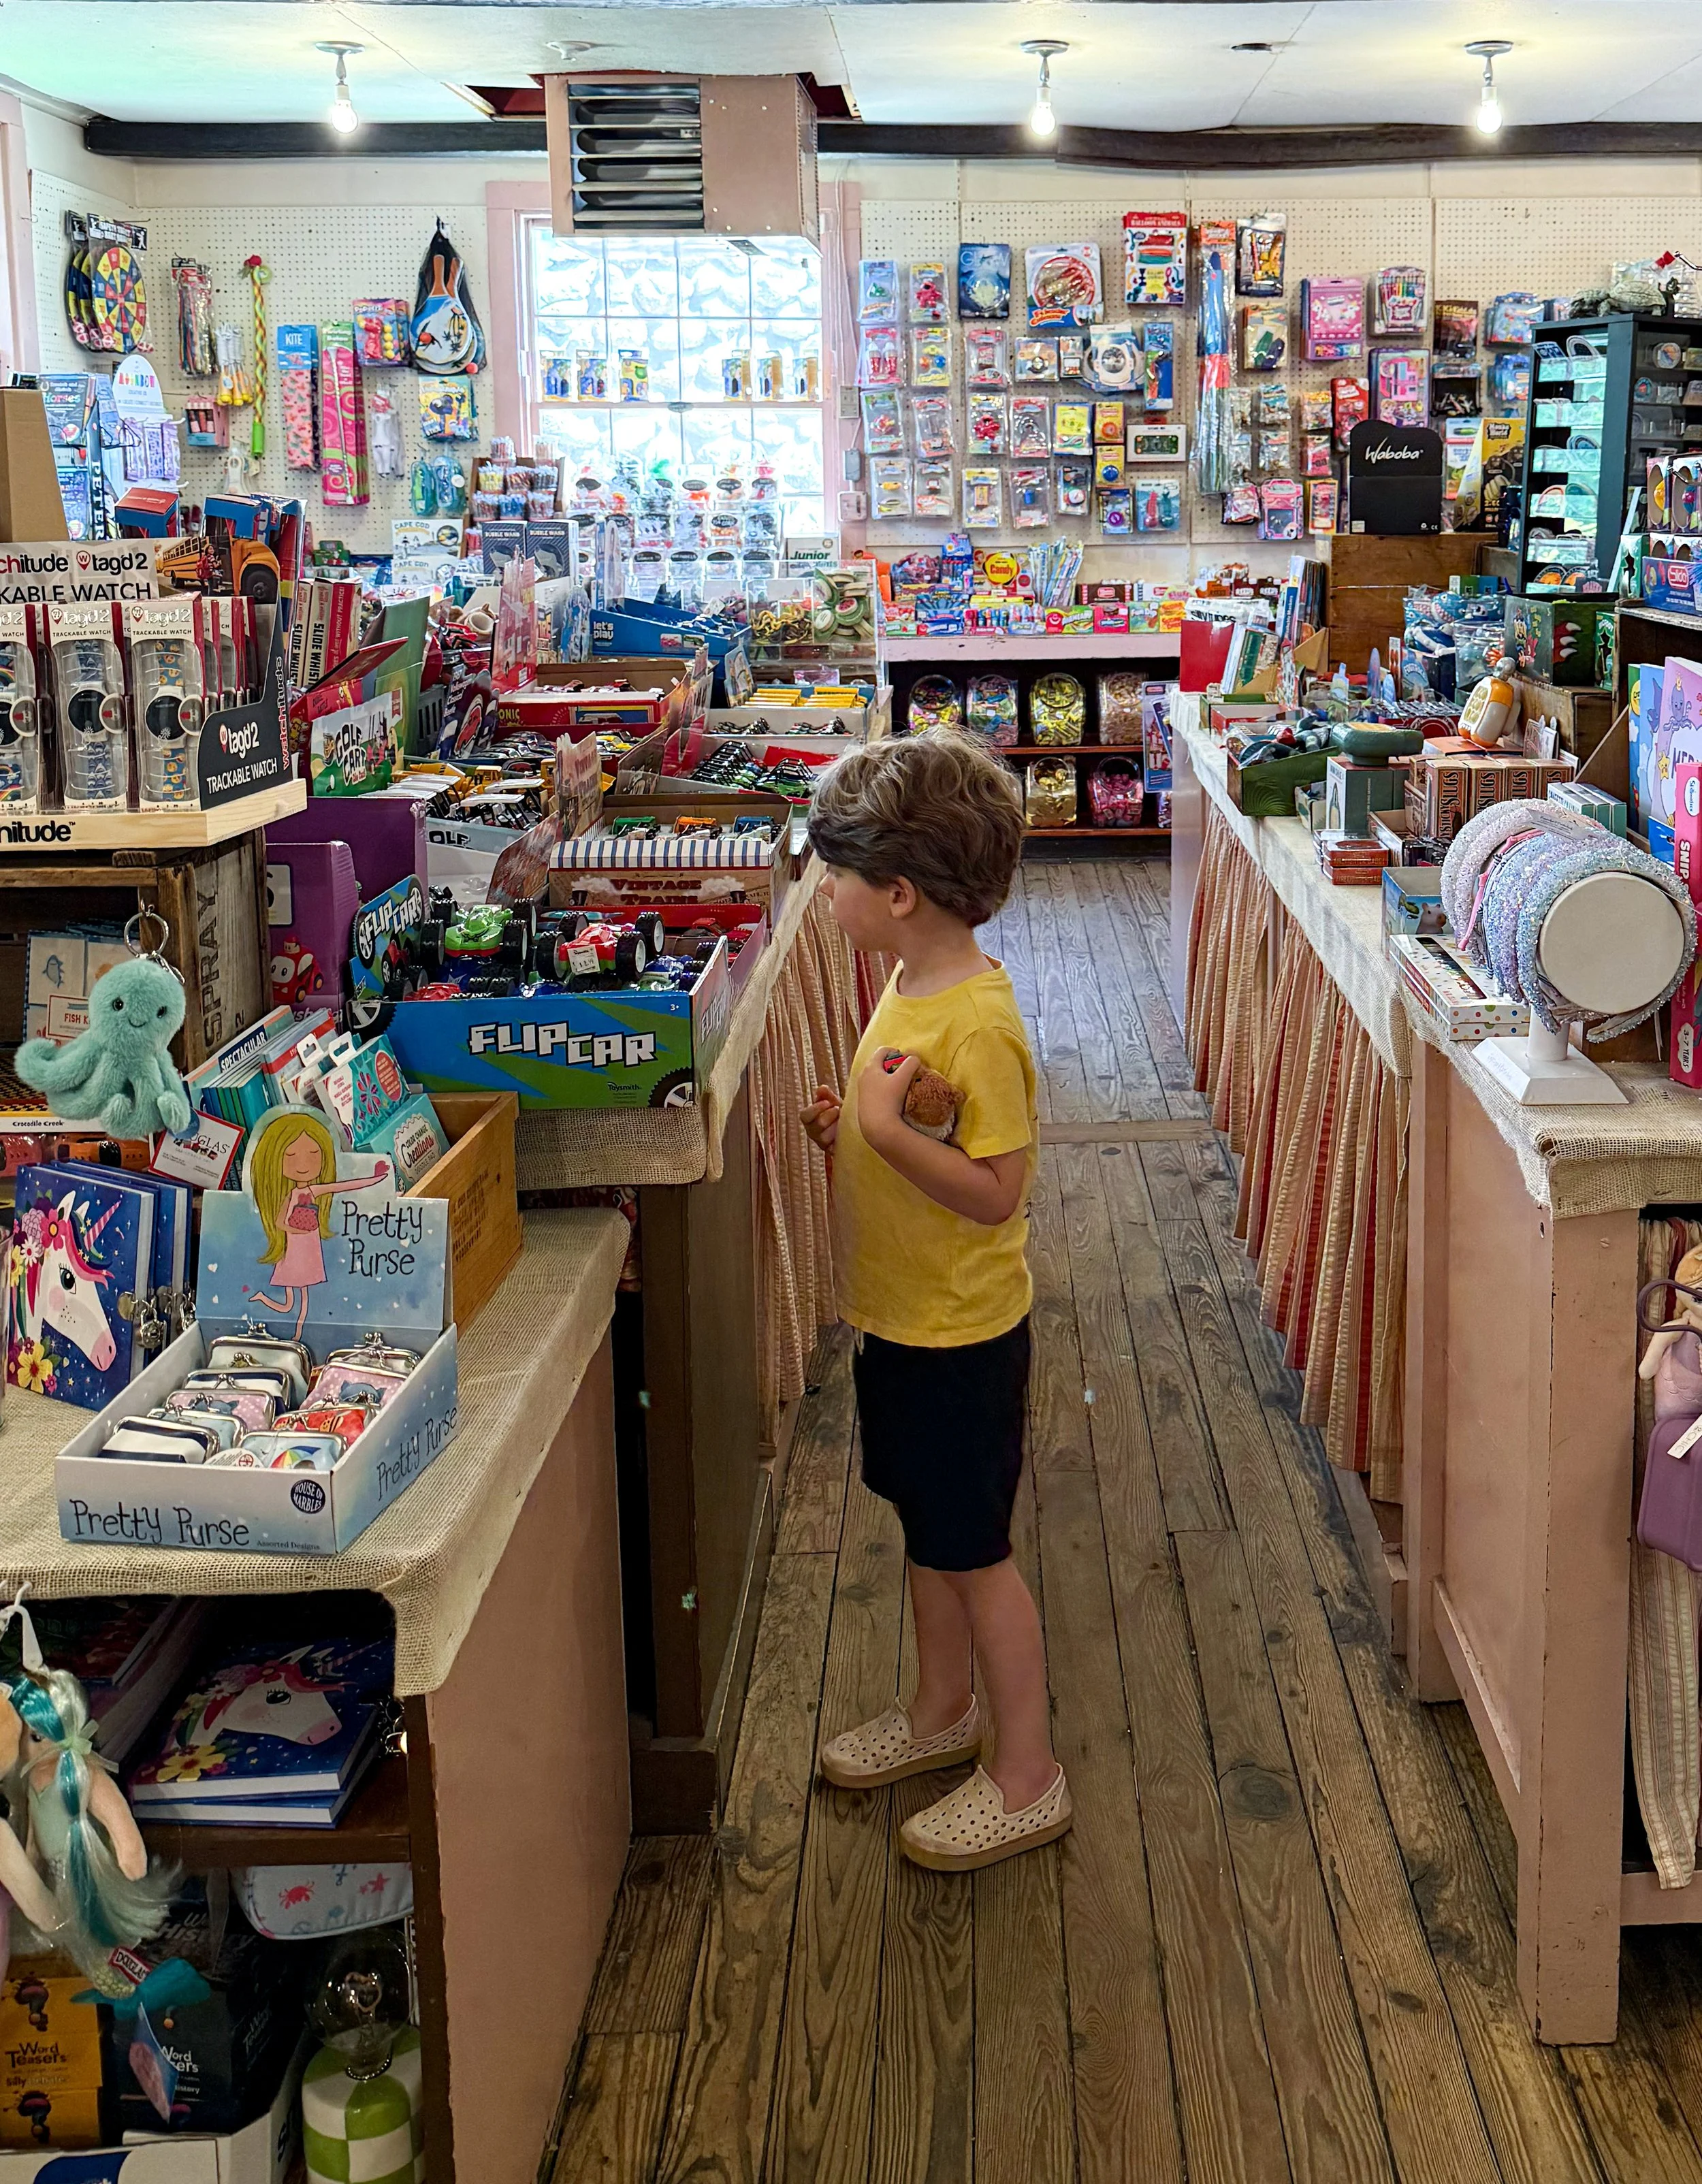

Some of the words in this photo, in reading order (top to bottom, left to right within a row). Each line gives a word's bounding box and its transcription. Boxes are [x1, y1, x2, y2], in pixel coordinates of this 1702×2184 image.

[285, 332, 303, 346] KITE
[1365, 436, 1420, 464] Waboba
[91, 461, 107, 541] PETER
[135, 552, 148, 570] 2
[790, 550, 831, 560] Junior
[70, 581, 152, 602] WATCH
[312, 622, 325, 651] SLIDE
[335, 613, 343, 638] WITHOUT
[593, 621, 614, 630] let's
[593, 630, 614, 640] play
[275, 656, 291, 771] watchitude
[498, 708, 520, 720] ONIC
[251, 721, 260, 748] 2
[335, 723, 362, 767] GOLF
[206, 765, 251, 794] TRACKABLE
[251, 757, 278, 780] WATCH
[342, 746, 366, 786] CART
[1511, 770, 1528, 799] LUGS
[428, 829, 470, 846] OLF
[610, 878, 702, 890] VINTAGE
[196, 889, 223, 1048] SPRAY
[64, 1013, 81, 1024] FISH
[220, 1030, 268, 1074] SPECTACULAR
[191, 1132, 230, 1154] UGLAS
[400, 1134, 434, 1169] Creations
[341, 1200, 423, 1244] Pretty
[348, 1239, 415, 1278] Purse
[376, 1434, 421, 1501] Pretty
[422, 1405, 458, 1456] Purse
[294, 1481, 317, 1497] HOUSE
[293, 1493, 322, 1512] MARBLES
[69, 1499, 162, 1545] Pretty
[172, 1507, 251, 1547] Purse
[257, 1539, 289, 1549] Assorted
[291, 1541, 321, 1551] Designs
[5, 2050, 67, 2069] Teasers
[19, 2041, 60, 2056] Word
[175, 2084, 200, 2095] istory
